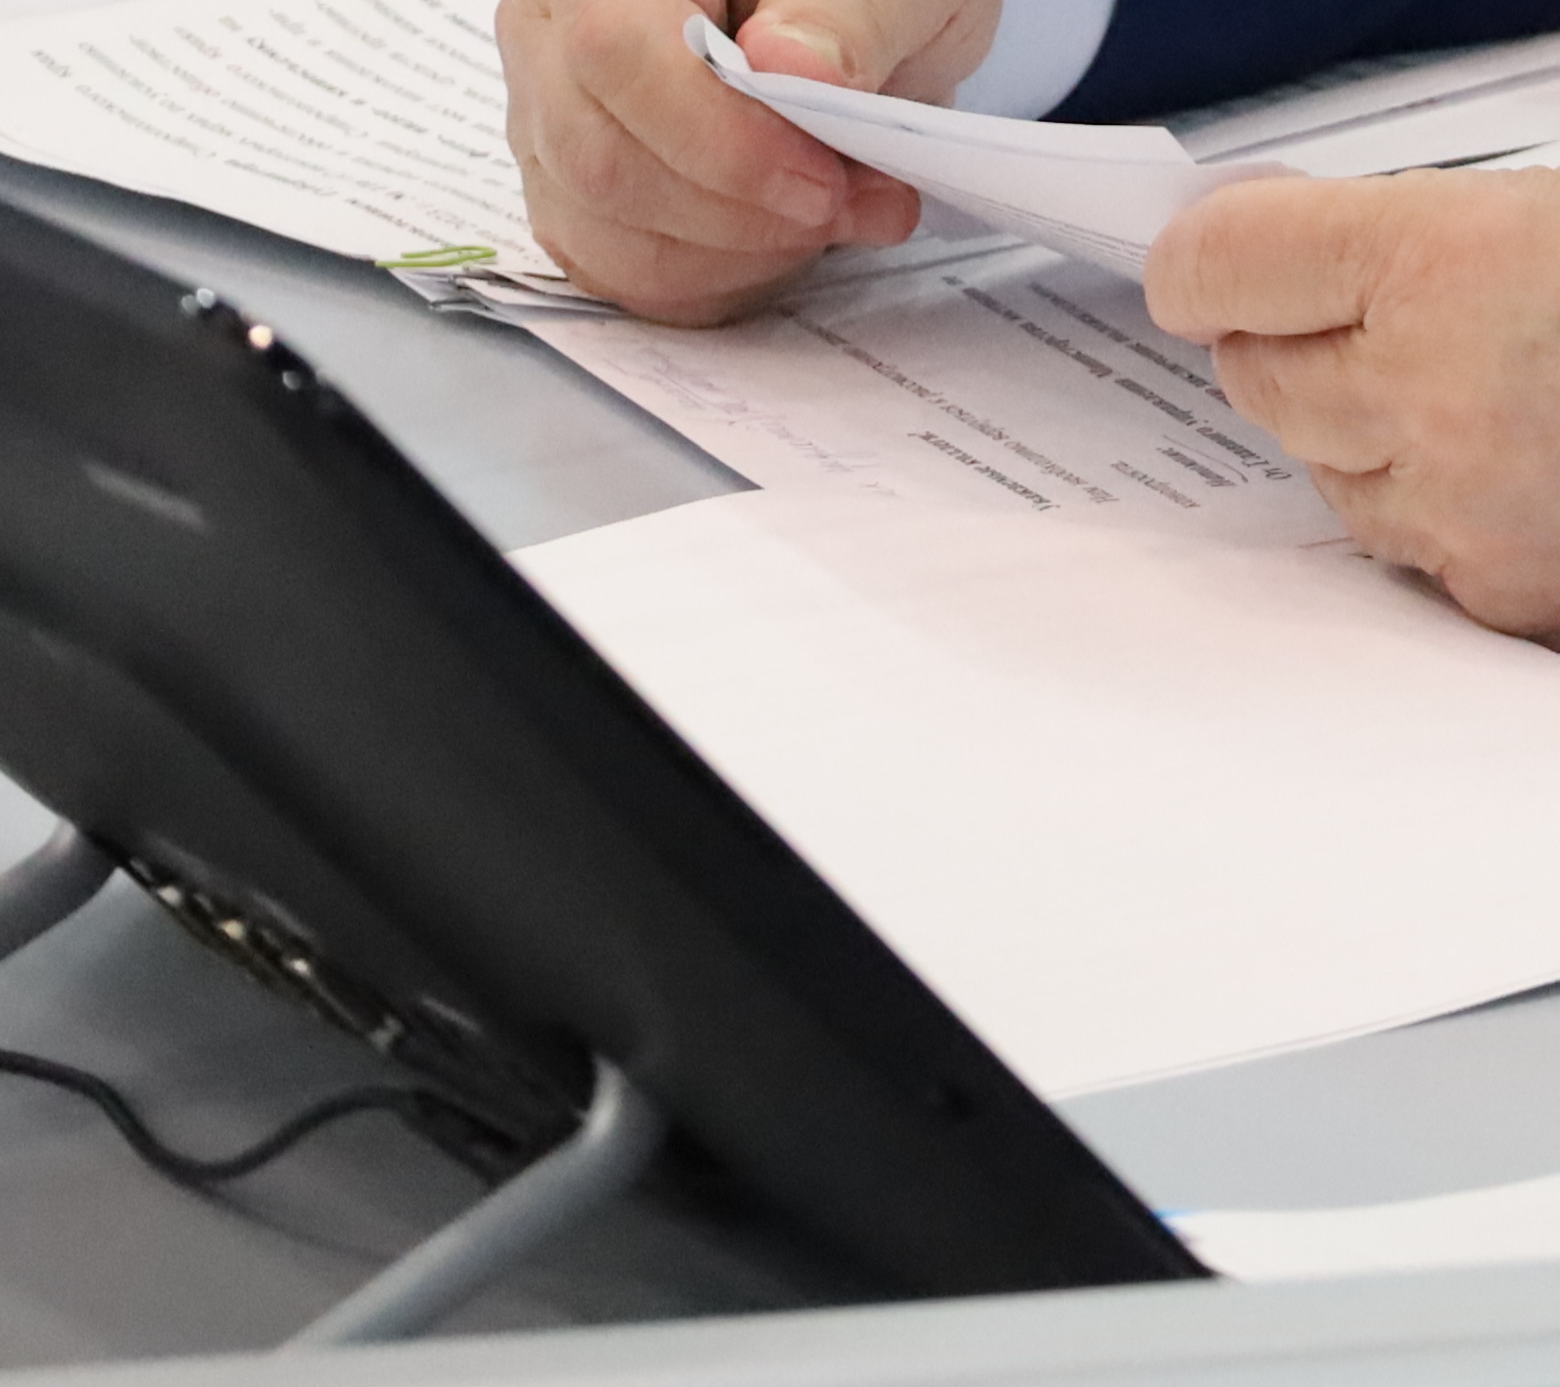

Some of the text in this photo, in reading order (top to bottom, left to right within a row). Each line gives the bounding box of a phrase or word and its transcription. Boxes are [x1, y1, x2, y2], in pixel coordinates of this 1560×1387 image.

[1019, 322, 1120, 379] Министерства
[1114, 378, 1209, 426] управления
[1004, 441, 1089, 486] необходимо
[1196, 427, 1270, 468] Главного
[974, 466, 1060, 511] Уважаемые
[1082, 486, 1120, 504] Нам
[1263, 467, 1292, 480] От
